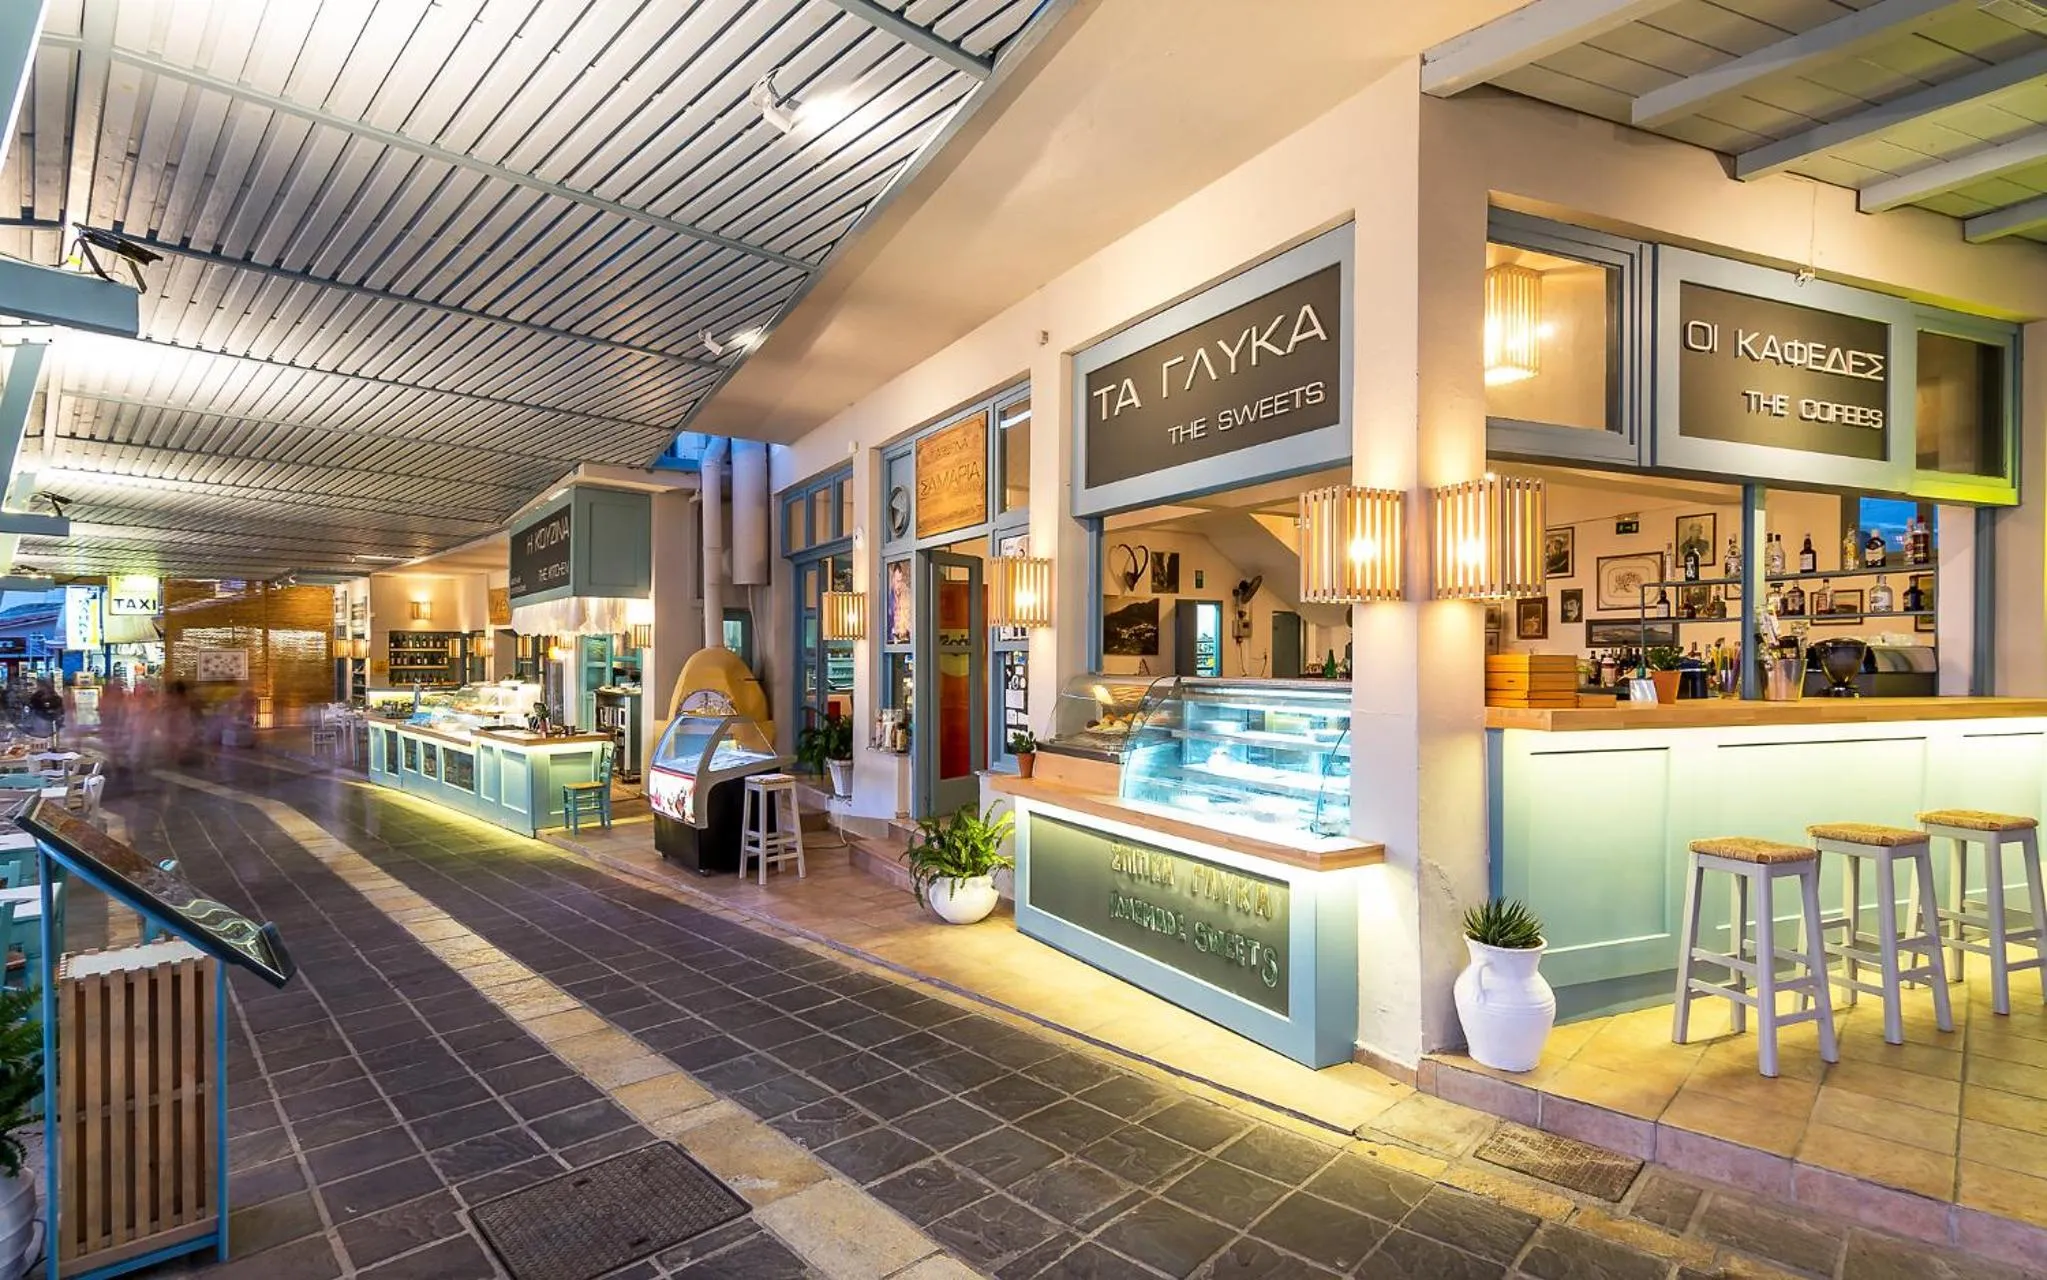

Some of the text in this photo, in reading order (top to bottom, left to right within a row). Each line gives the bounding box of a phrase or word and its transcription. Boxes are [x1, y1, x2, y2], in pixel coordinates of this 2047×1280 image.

[1093, 304, 1328, 421] ΤΑ ΓΛΥΚΑ
[1686, 320, 1884, 381] ΟΙ ΚΑΦΕΔΕΣ
[1168, 381, 1326, 445] THE SWEETS
[1743, 390, 1883, 430] THE COFEES
[113, 598, 157, 611] TAXI
[1194, 920, 1279, 988] SWEETS
